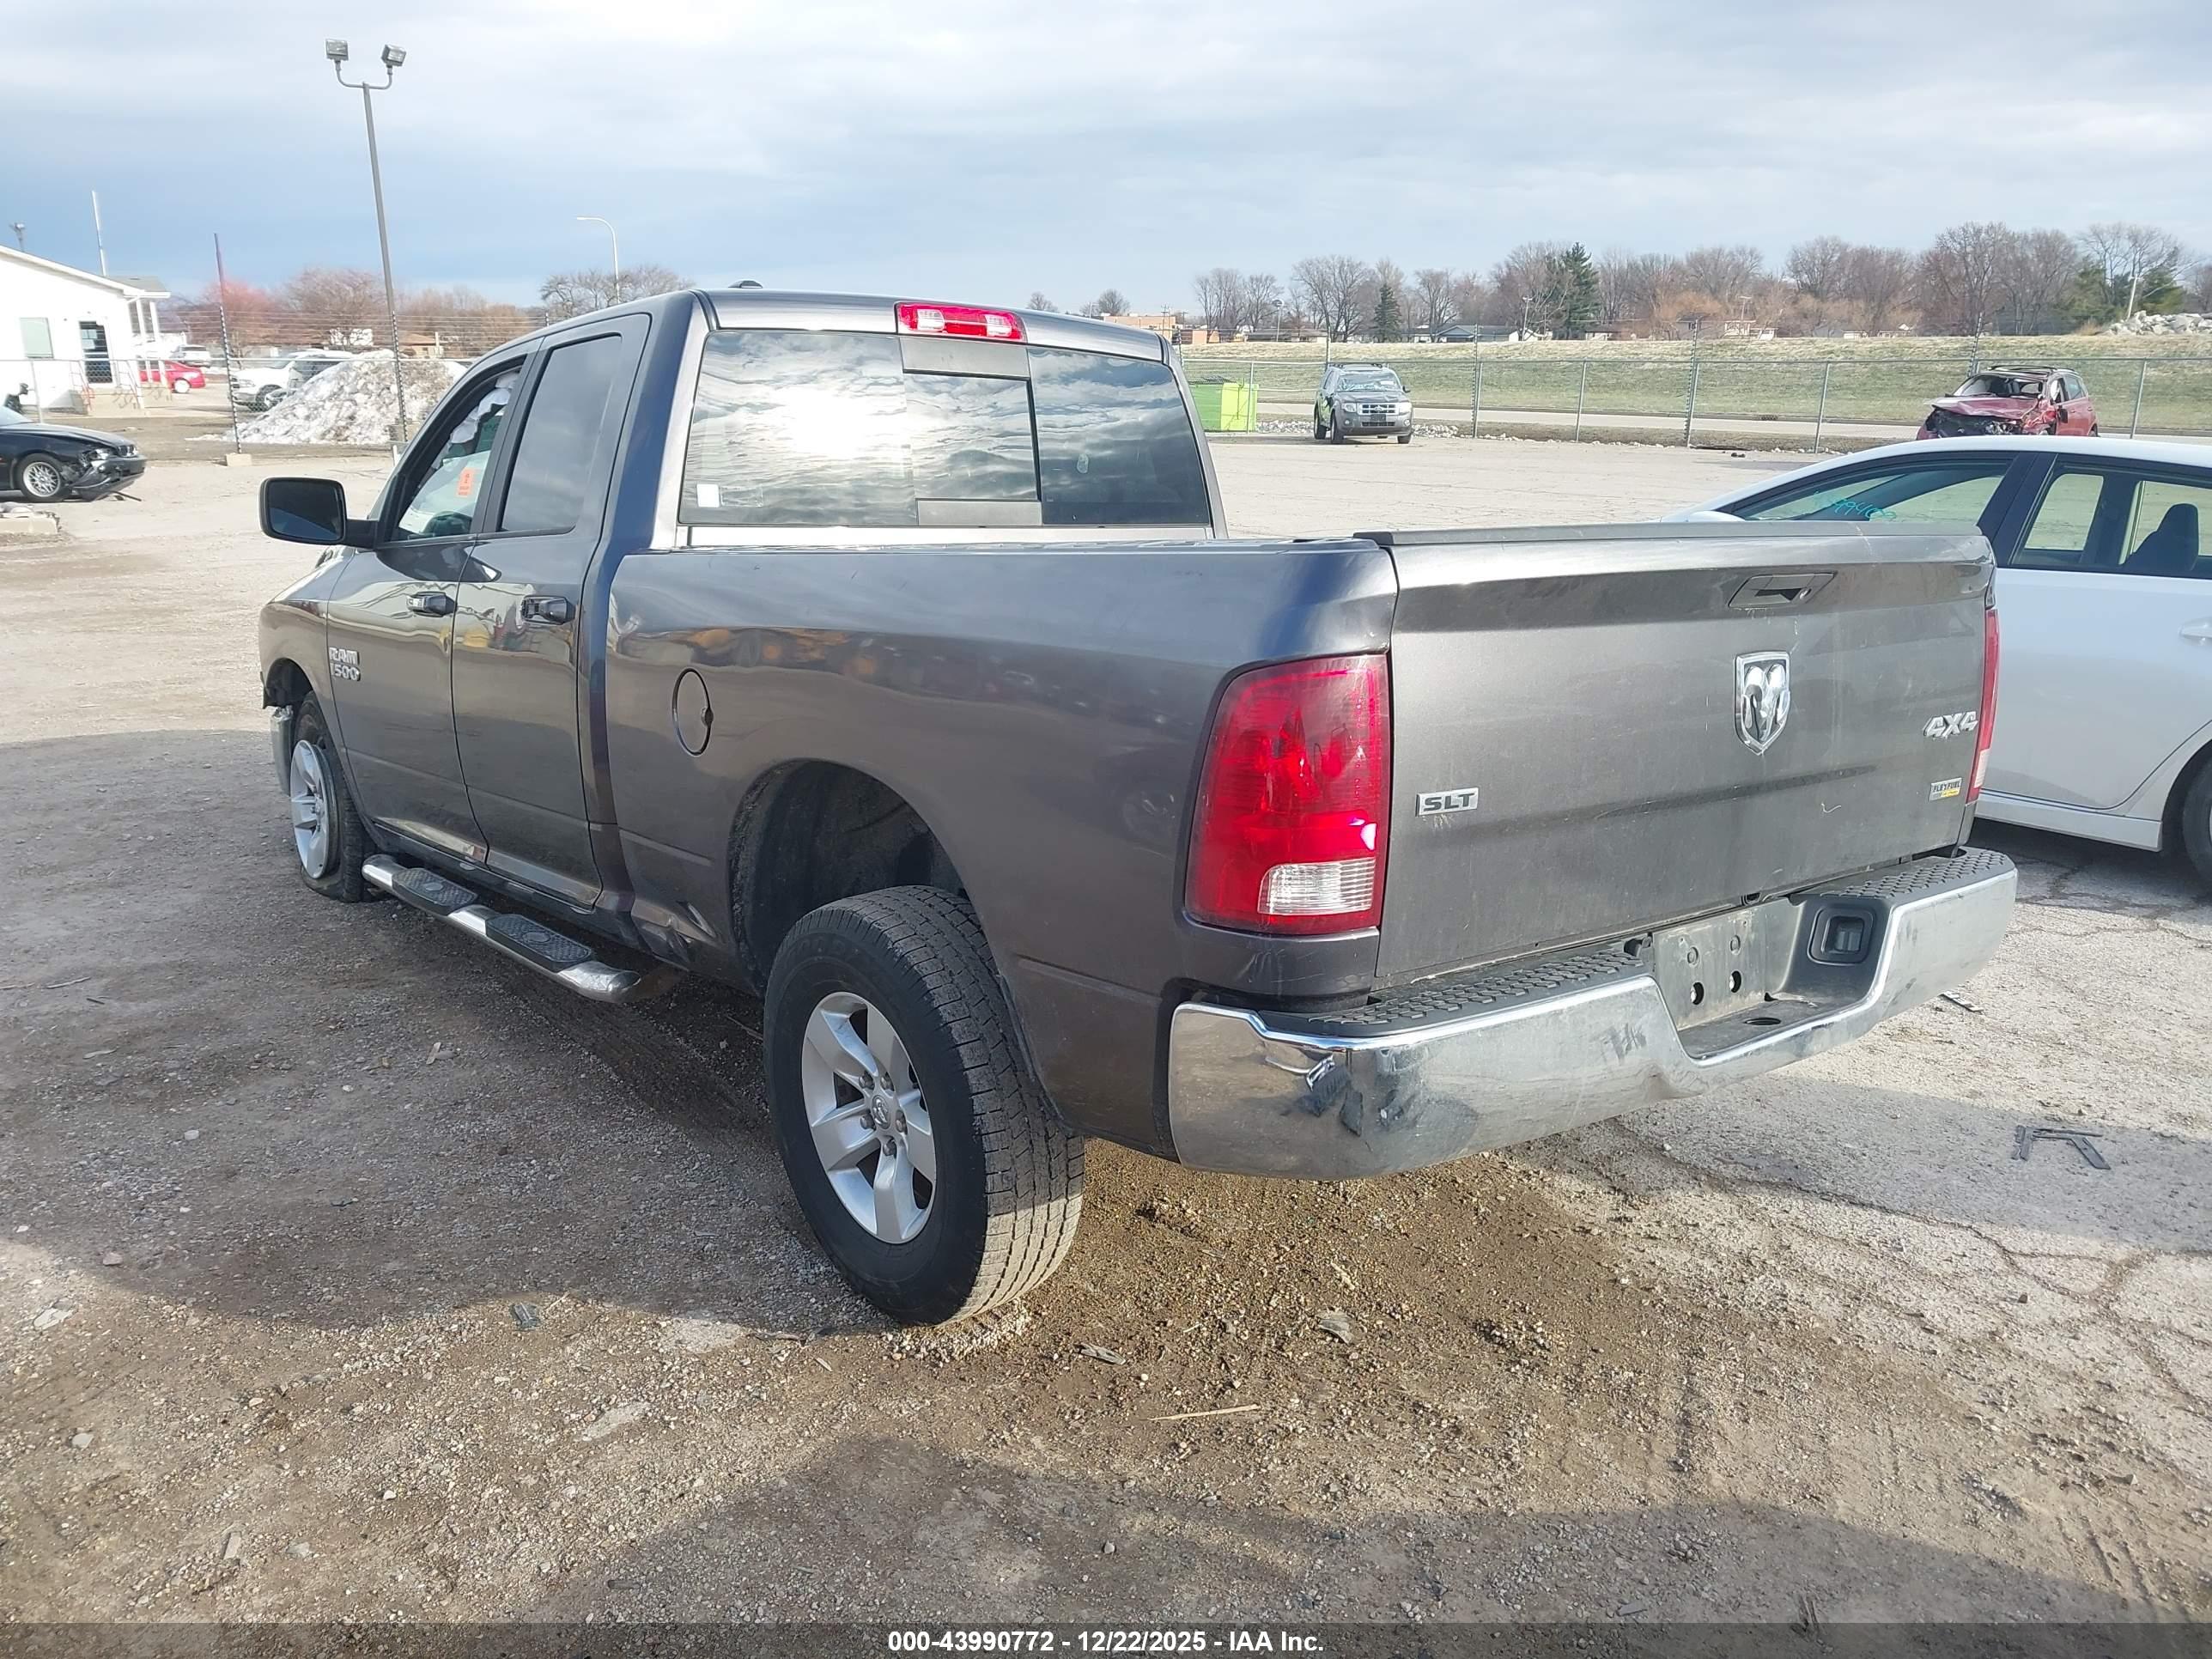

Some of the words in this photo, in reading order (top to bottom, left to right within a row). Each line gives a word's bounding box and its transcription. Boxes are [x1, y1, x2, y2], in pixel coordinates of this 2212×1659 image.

[329, 647, 359, 665] RAM
[330, 662, 361, 681] 1500
[1423, 793, 1475, 811] SLT
